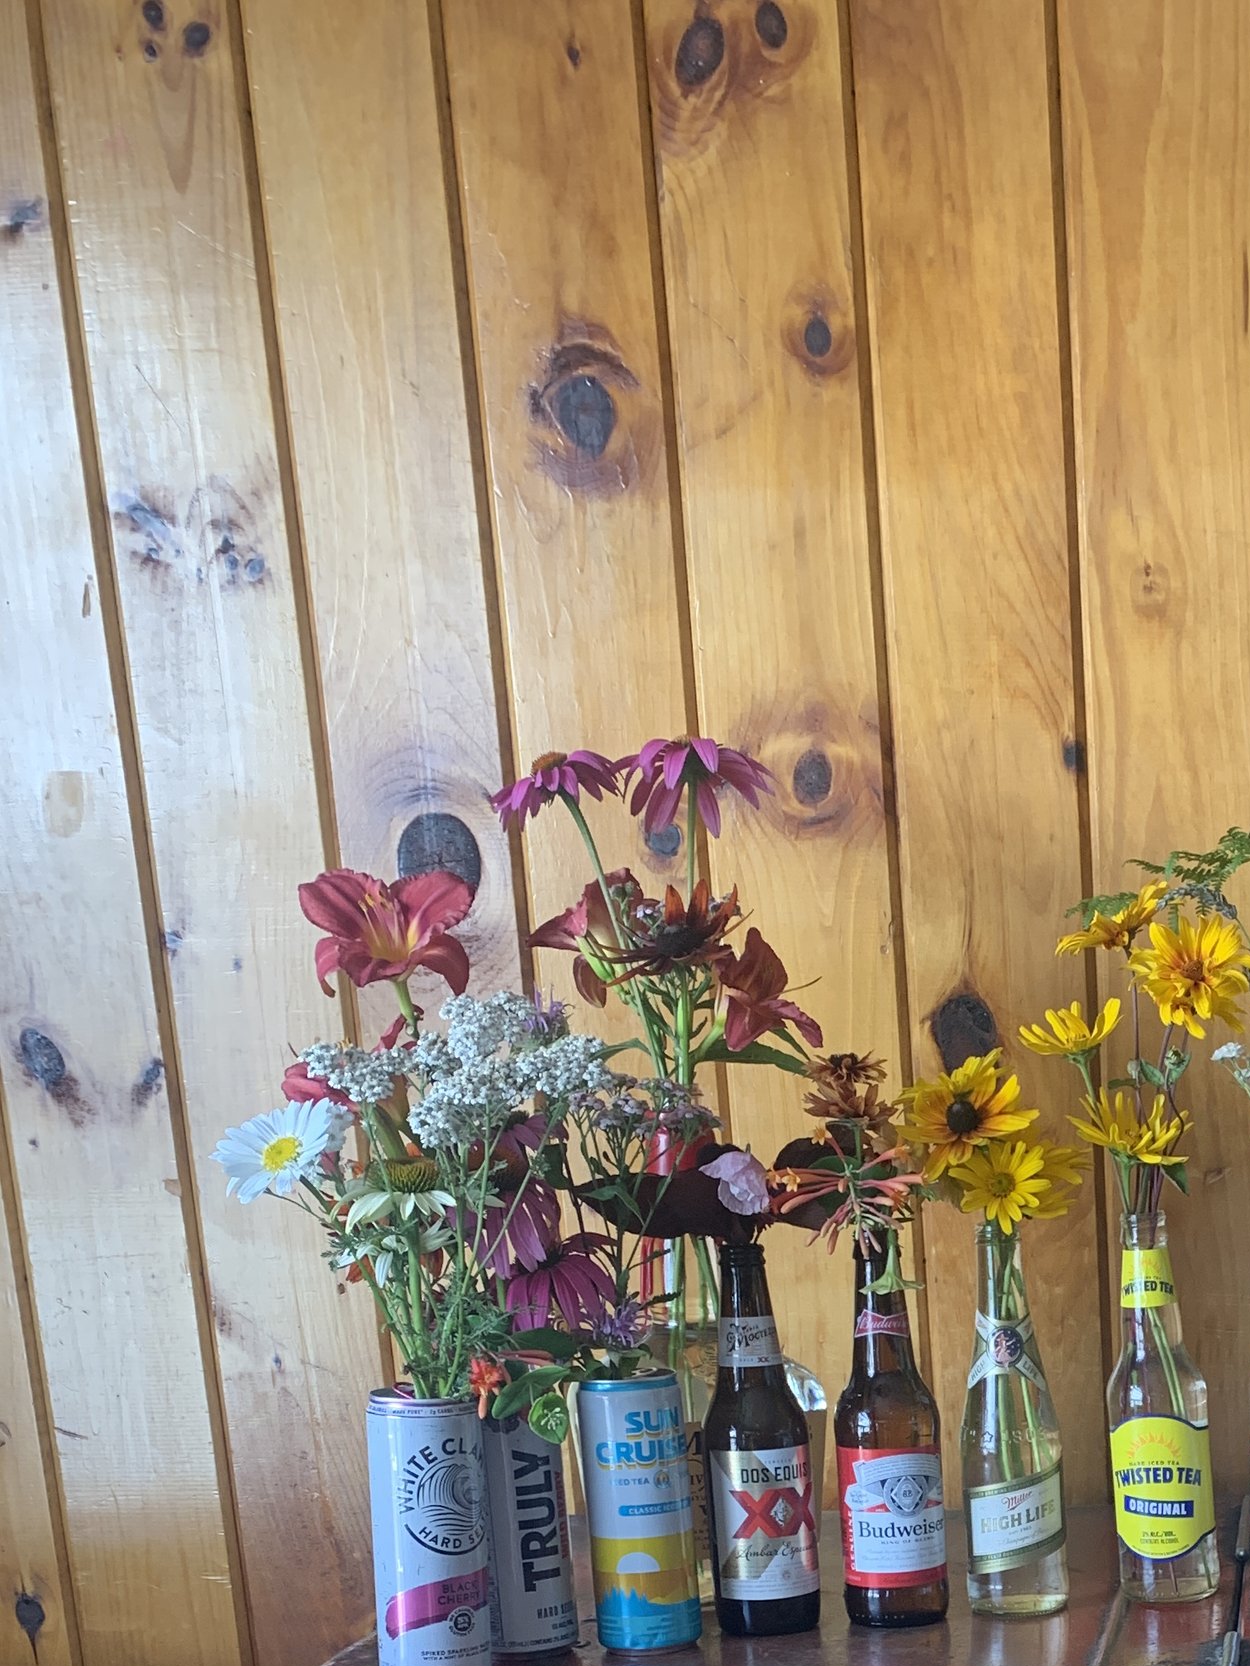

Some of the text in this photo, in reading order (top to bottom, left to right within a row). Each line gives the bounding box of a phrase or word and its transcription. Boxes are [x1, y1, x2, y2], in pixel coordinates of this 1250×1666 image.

[1159, 1281, 1174, 1295] TEA
[624, 1406, 680, 1436] SUN
[397, 1445, 439, 1515] WHITE
[632, 1477, 650, 1486] TEA
[741, 1462, 808, 1484] DOS EQUIS
[1115, 1467, 1202, 1488] TWISTED TEA
[1001, 1490, 1033, 1509] Miller
[1128, 1498, 1188, 1515] ORIGINAL
[511, 1449, 562, 1593] TRULY
[628, 1506, 662, 1515] CLASSIC
[728, 1482, 816, 1540] XX
[980, 1500, 1055, 1534] HIGH LIFE
[418, 1526, 463, 1549] HARD
[858, 1518, 944, 1539] Budweiser
[442, 1581, 479, 1594] BLACK
[437, 1592, 480, 1606] CHERRY
